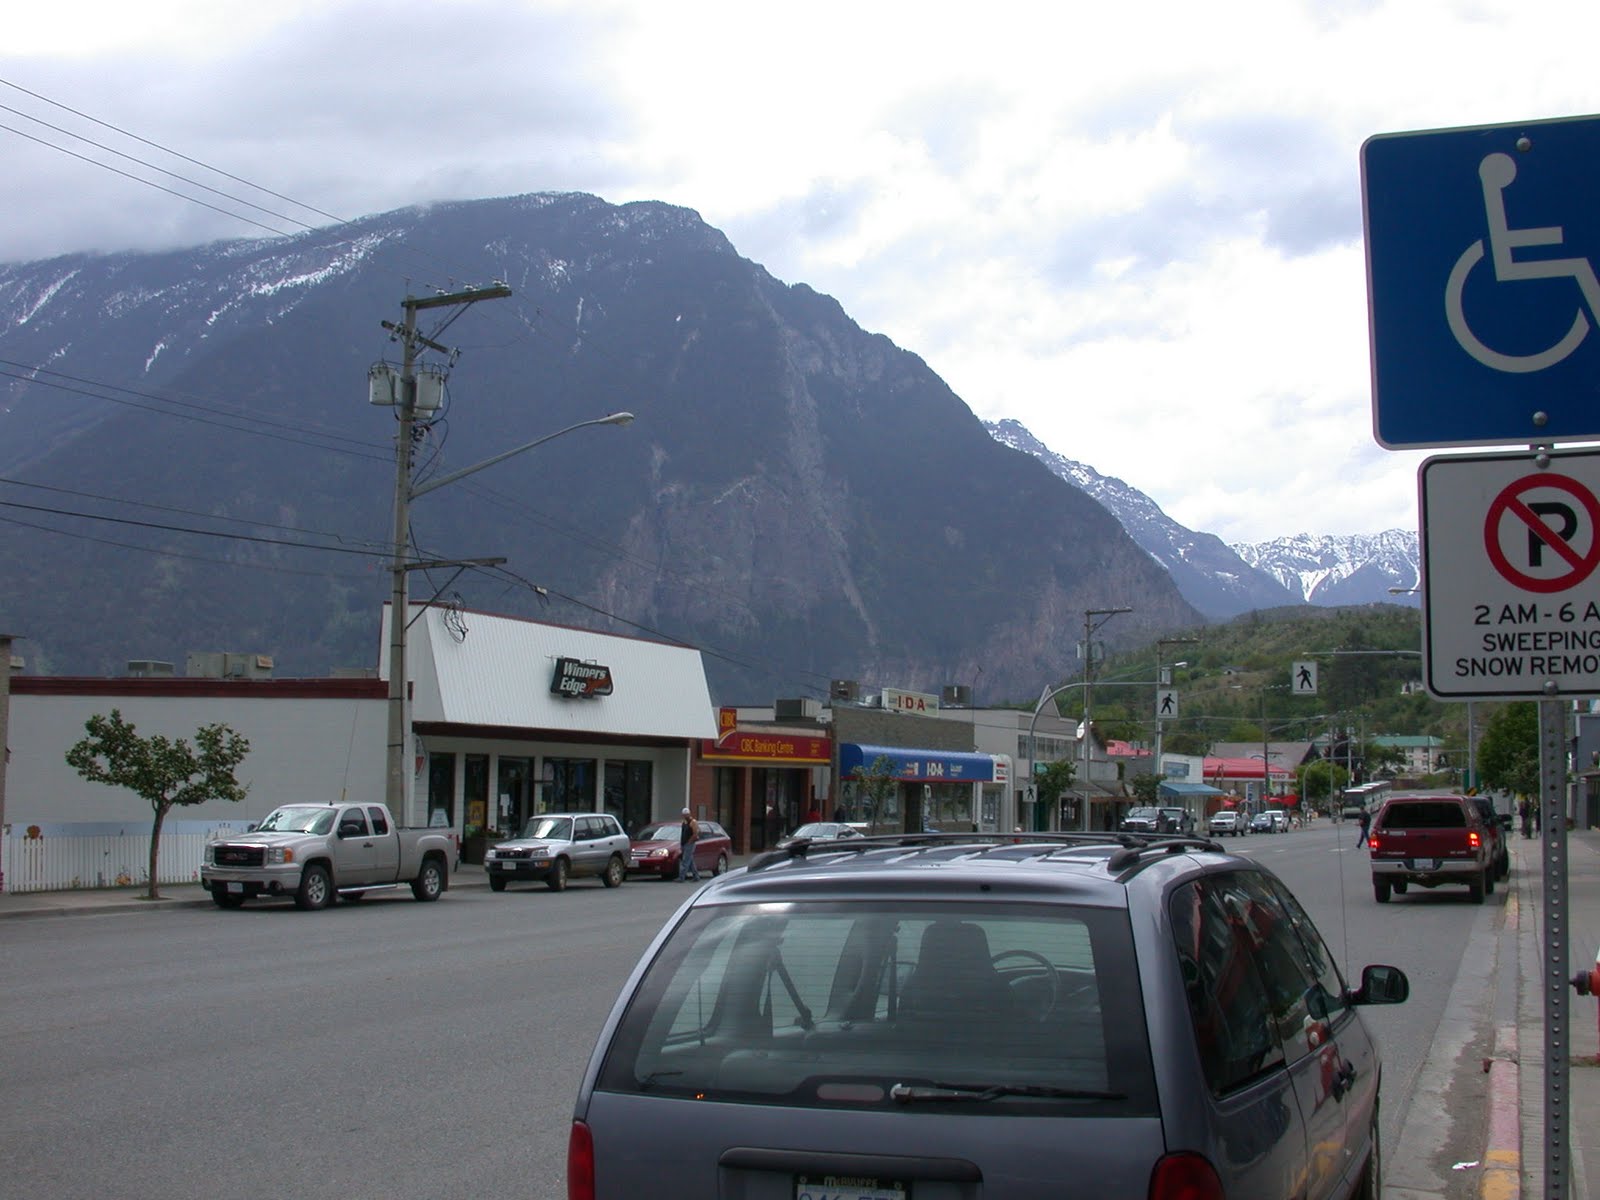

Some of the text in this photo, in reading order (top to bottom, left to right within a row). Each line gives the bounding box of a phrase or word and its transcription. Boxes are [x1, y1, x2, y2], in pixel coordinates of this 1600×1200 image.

[1475, 604, 1490, 625] 2
[1498, 603, 1537, 624] AM
[1559, 602, 1575, 623] 6
[1482, 630, 1600, 652] SWEEPING
[563, 662, 606, 679] Winners
[1455, 654, 1600, 677] SNOW REMO
[559, 677, 587, 695] Edge
[720, 711, 736, 728] CIBC
[741, 739, 754, 752] CIBC
[755, 738, 776, 757] Banking
[776, 740, 794, 755] Centre
